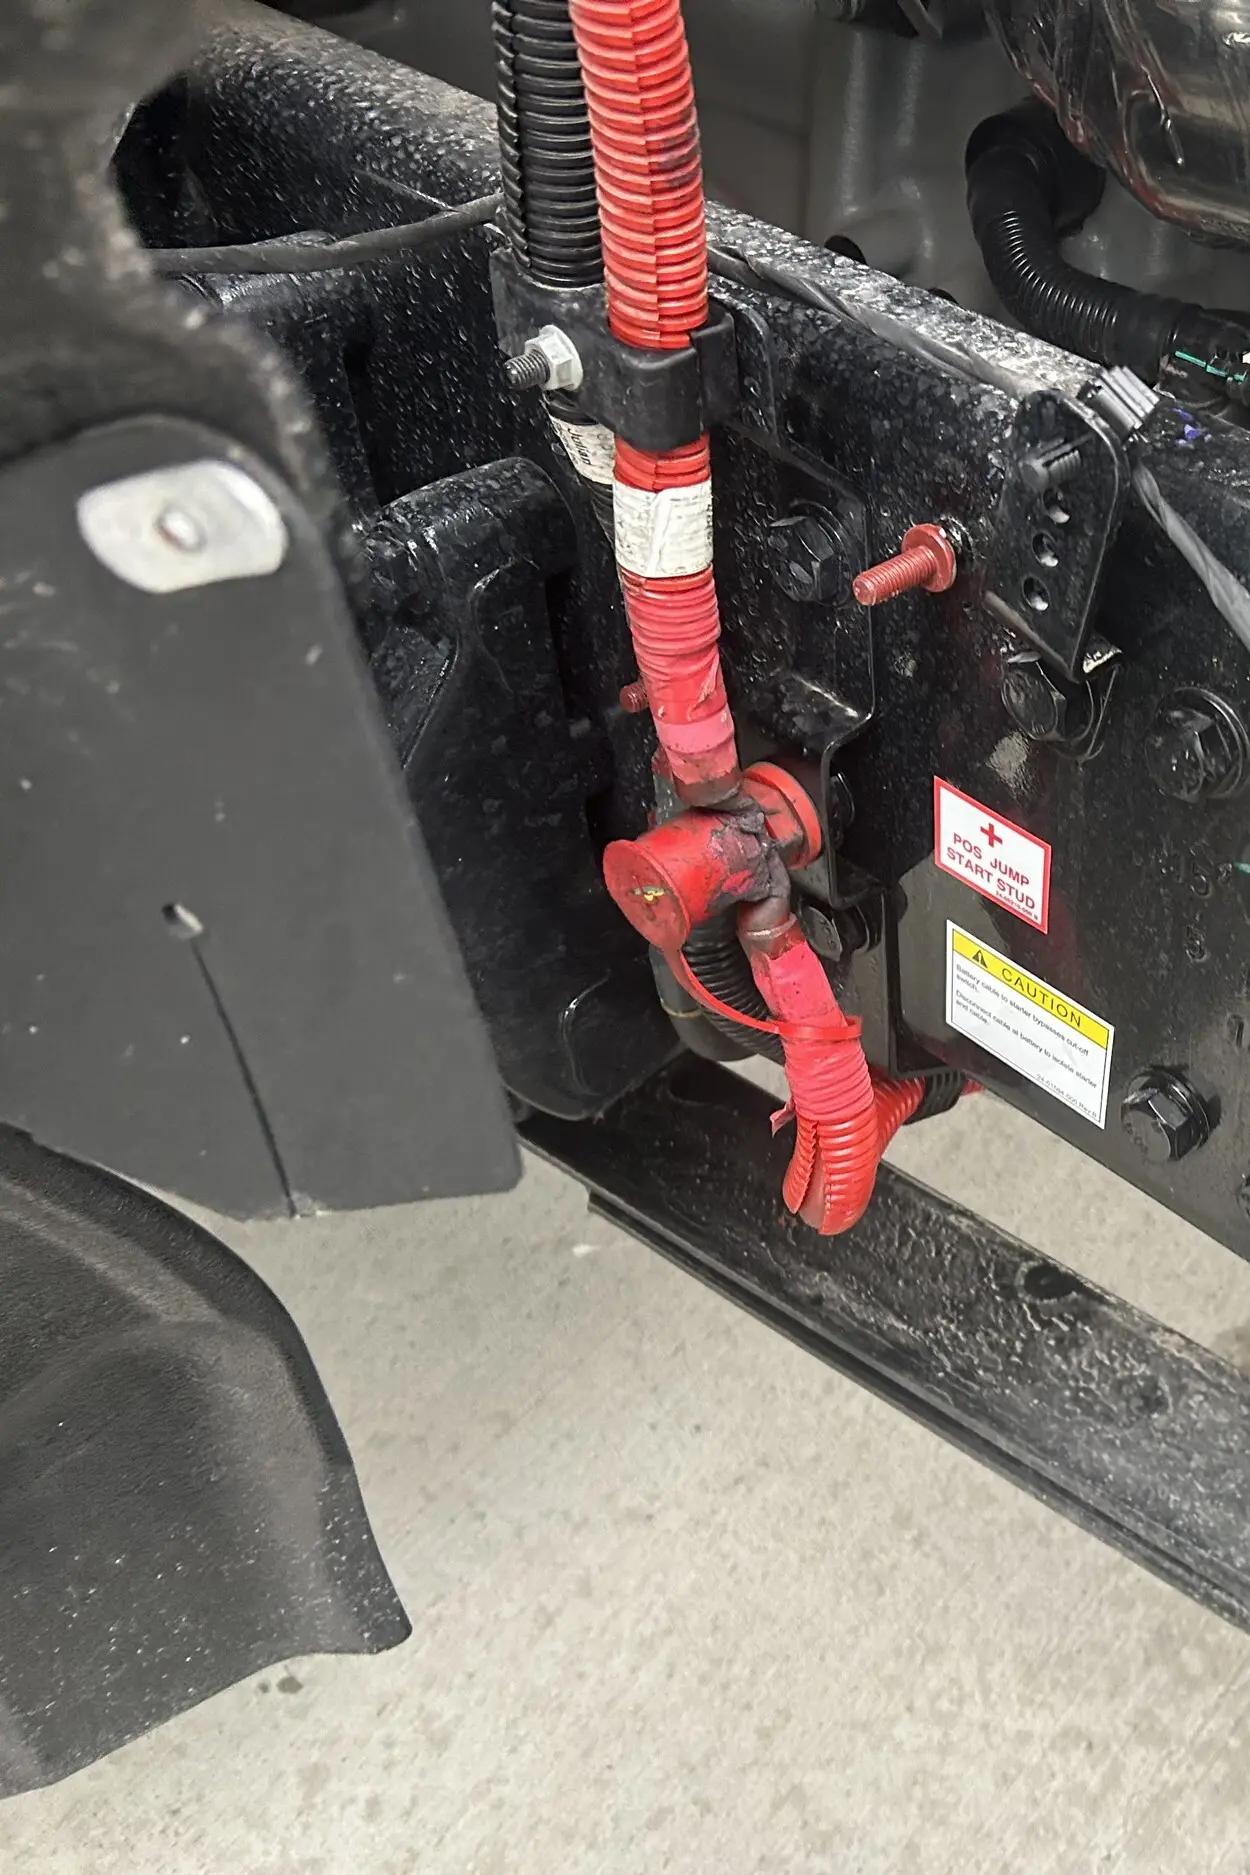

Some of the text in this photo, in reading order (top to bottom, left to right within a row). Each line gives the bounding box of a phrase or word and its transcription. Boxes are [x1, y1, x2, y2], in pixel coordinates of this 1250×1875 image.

[567, 427, 591, 466] Julian
[947, 847, 993, 883] START
[996, 878, 1035, 910] STUD
[953, 832, 1030, 886] POS JUMP
[1002, 968, 1081, 1028] CAUTION
